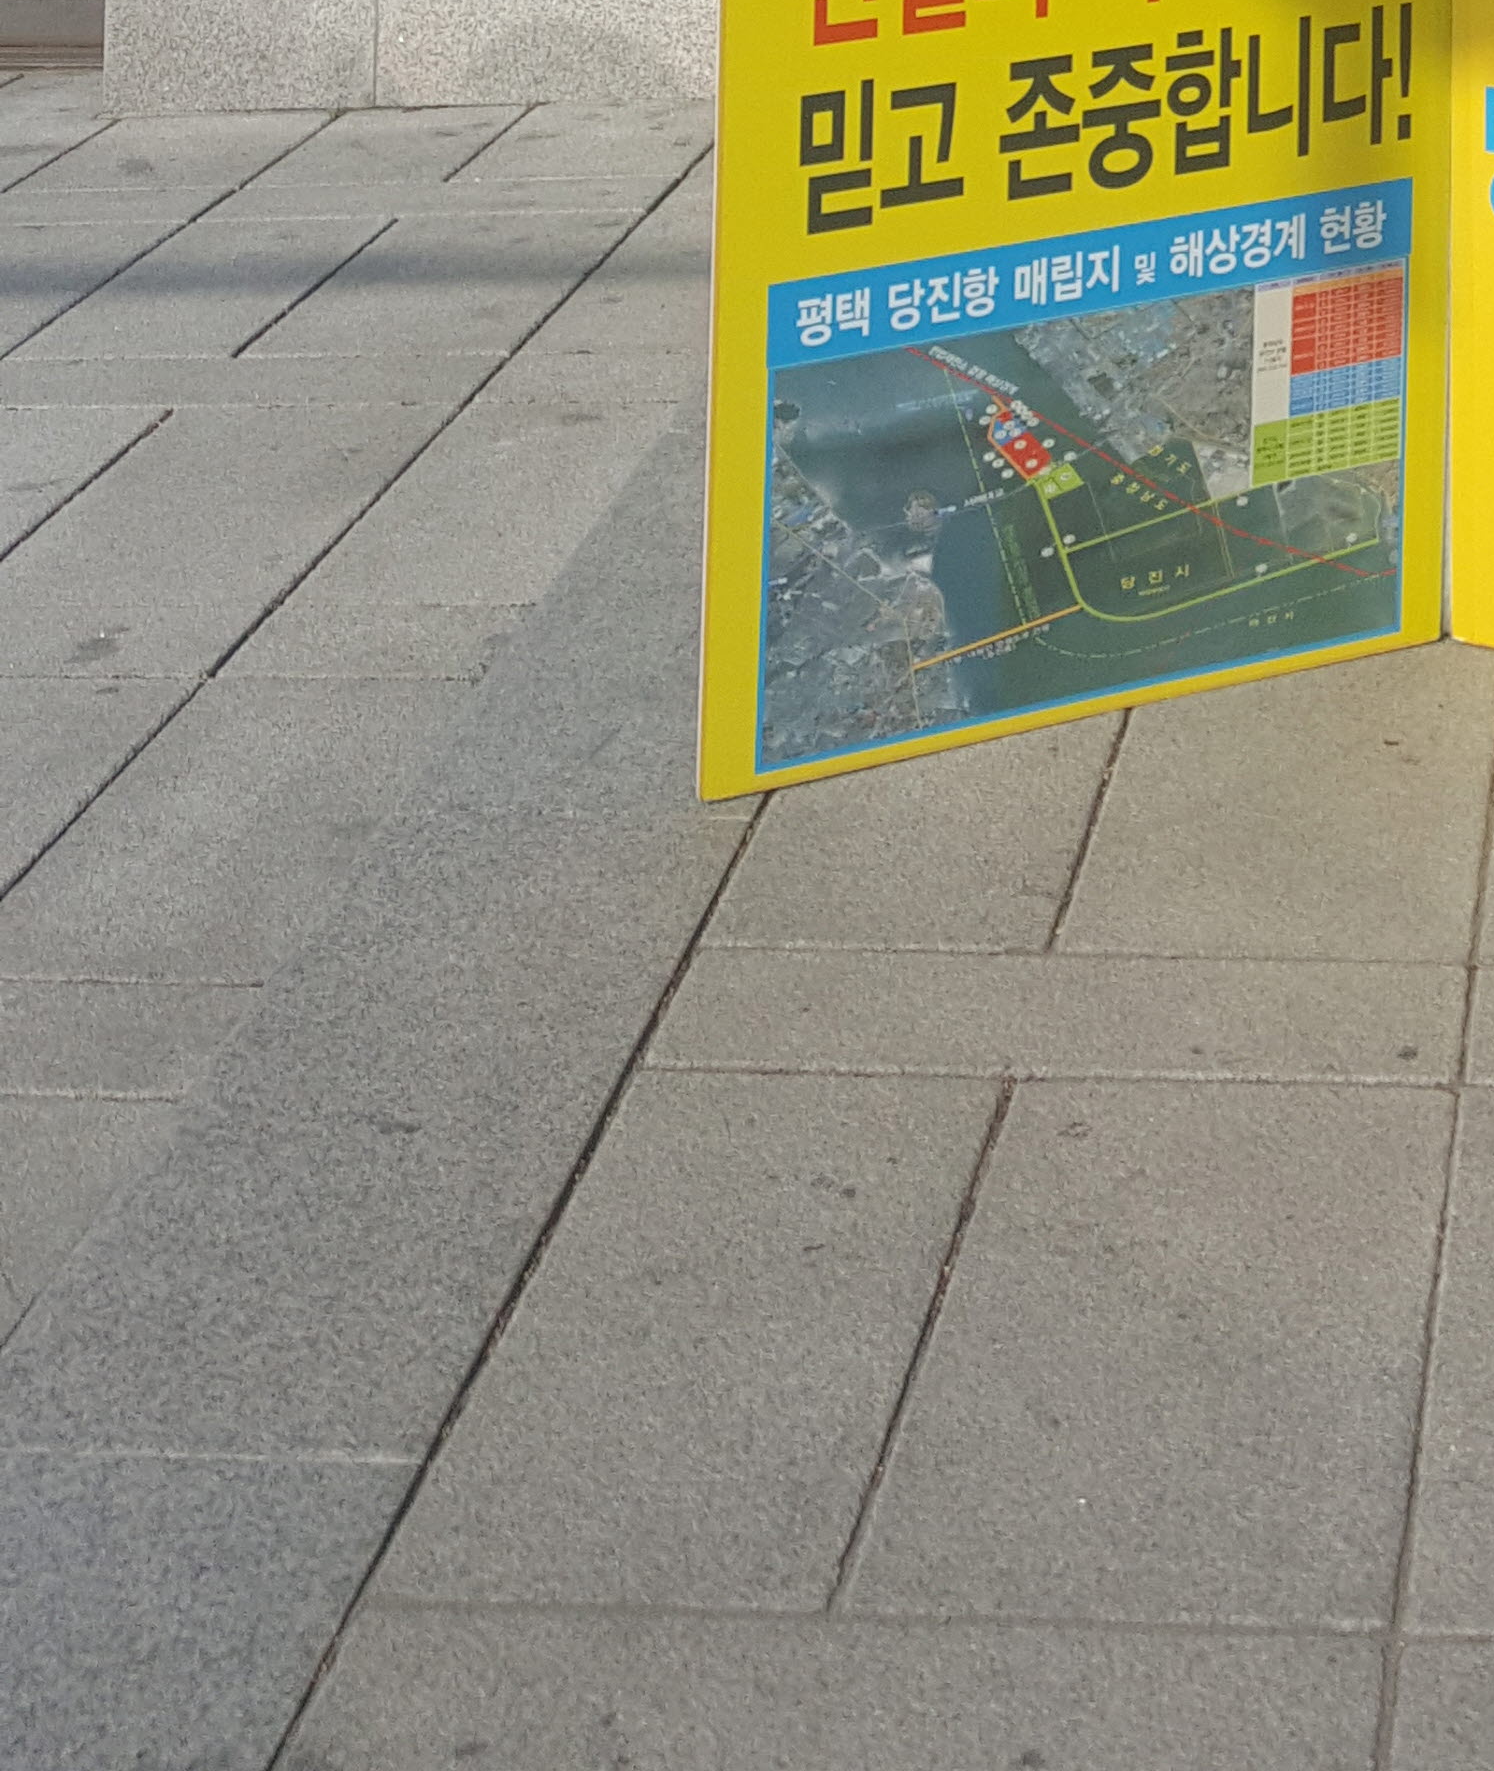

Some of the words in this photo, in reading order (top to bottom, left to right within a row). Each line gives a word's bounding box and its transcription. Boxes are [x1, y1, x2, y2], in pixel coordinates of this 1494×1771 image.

[800, 80, 963, 234] 믿고
[998, 2, 1413, 200] 존중합니다!
[796, 297, 870, 347] 평택
[888, 266, 998, 332] 당진항
[1014, 245, 1120, 307] 매립지
[1134, 252, 1156, 286] 및
[1169, 213, 1307, 278] 해상경계
[1320, 200, 1387, 256] 현황
